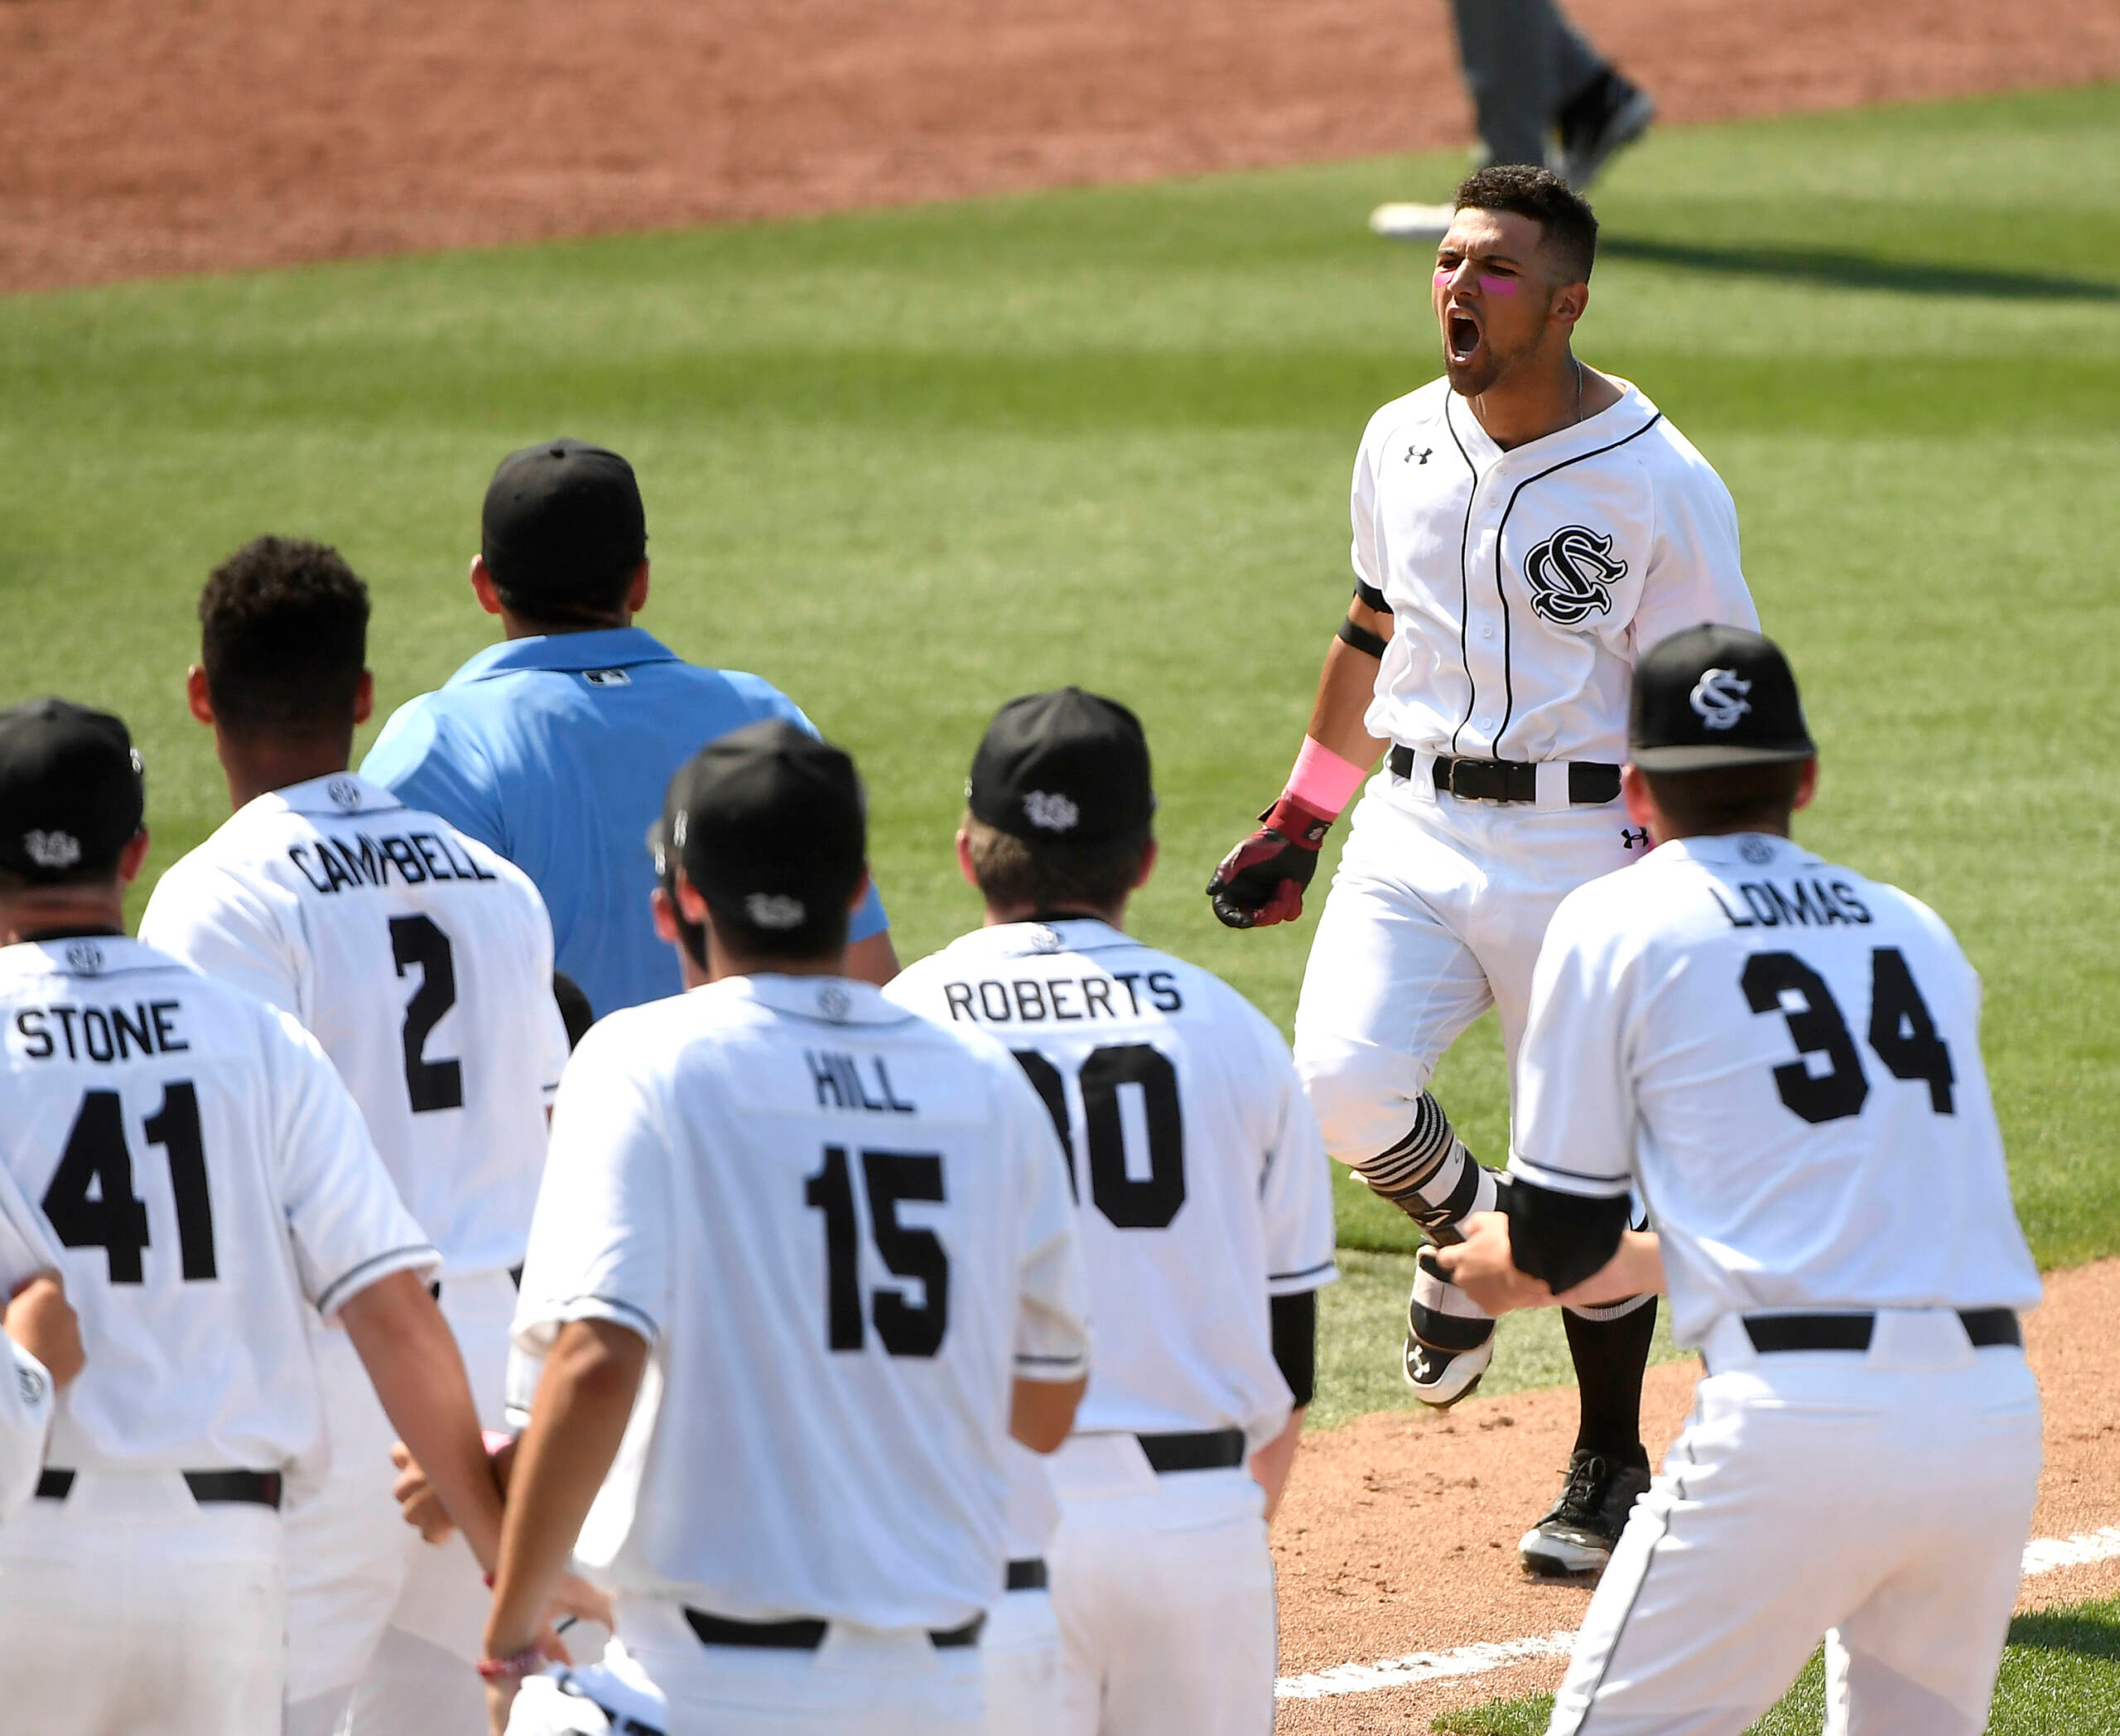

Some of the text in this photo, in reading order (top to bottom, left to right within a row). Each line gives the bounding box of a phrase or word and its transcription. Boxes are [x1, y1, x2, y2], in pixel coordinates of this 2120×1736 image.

[1711, 880, 1873, 928] LOMAS
[17, 1001, 190, 1063] STONE
[388, 914, 463, 1113] 2
[945, 972, 1183, 1022] ROBERTS
[1740, 948, 1954, 1124] 34
[805, 1050, 916, 1114] HILL
[41, 1081, 217, 1284] 41
[805, 1145, 949, 1359] 15
